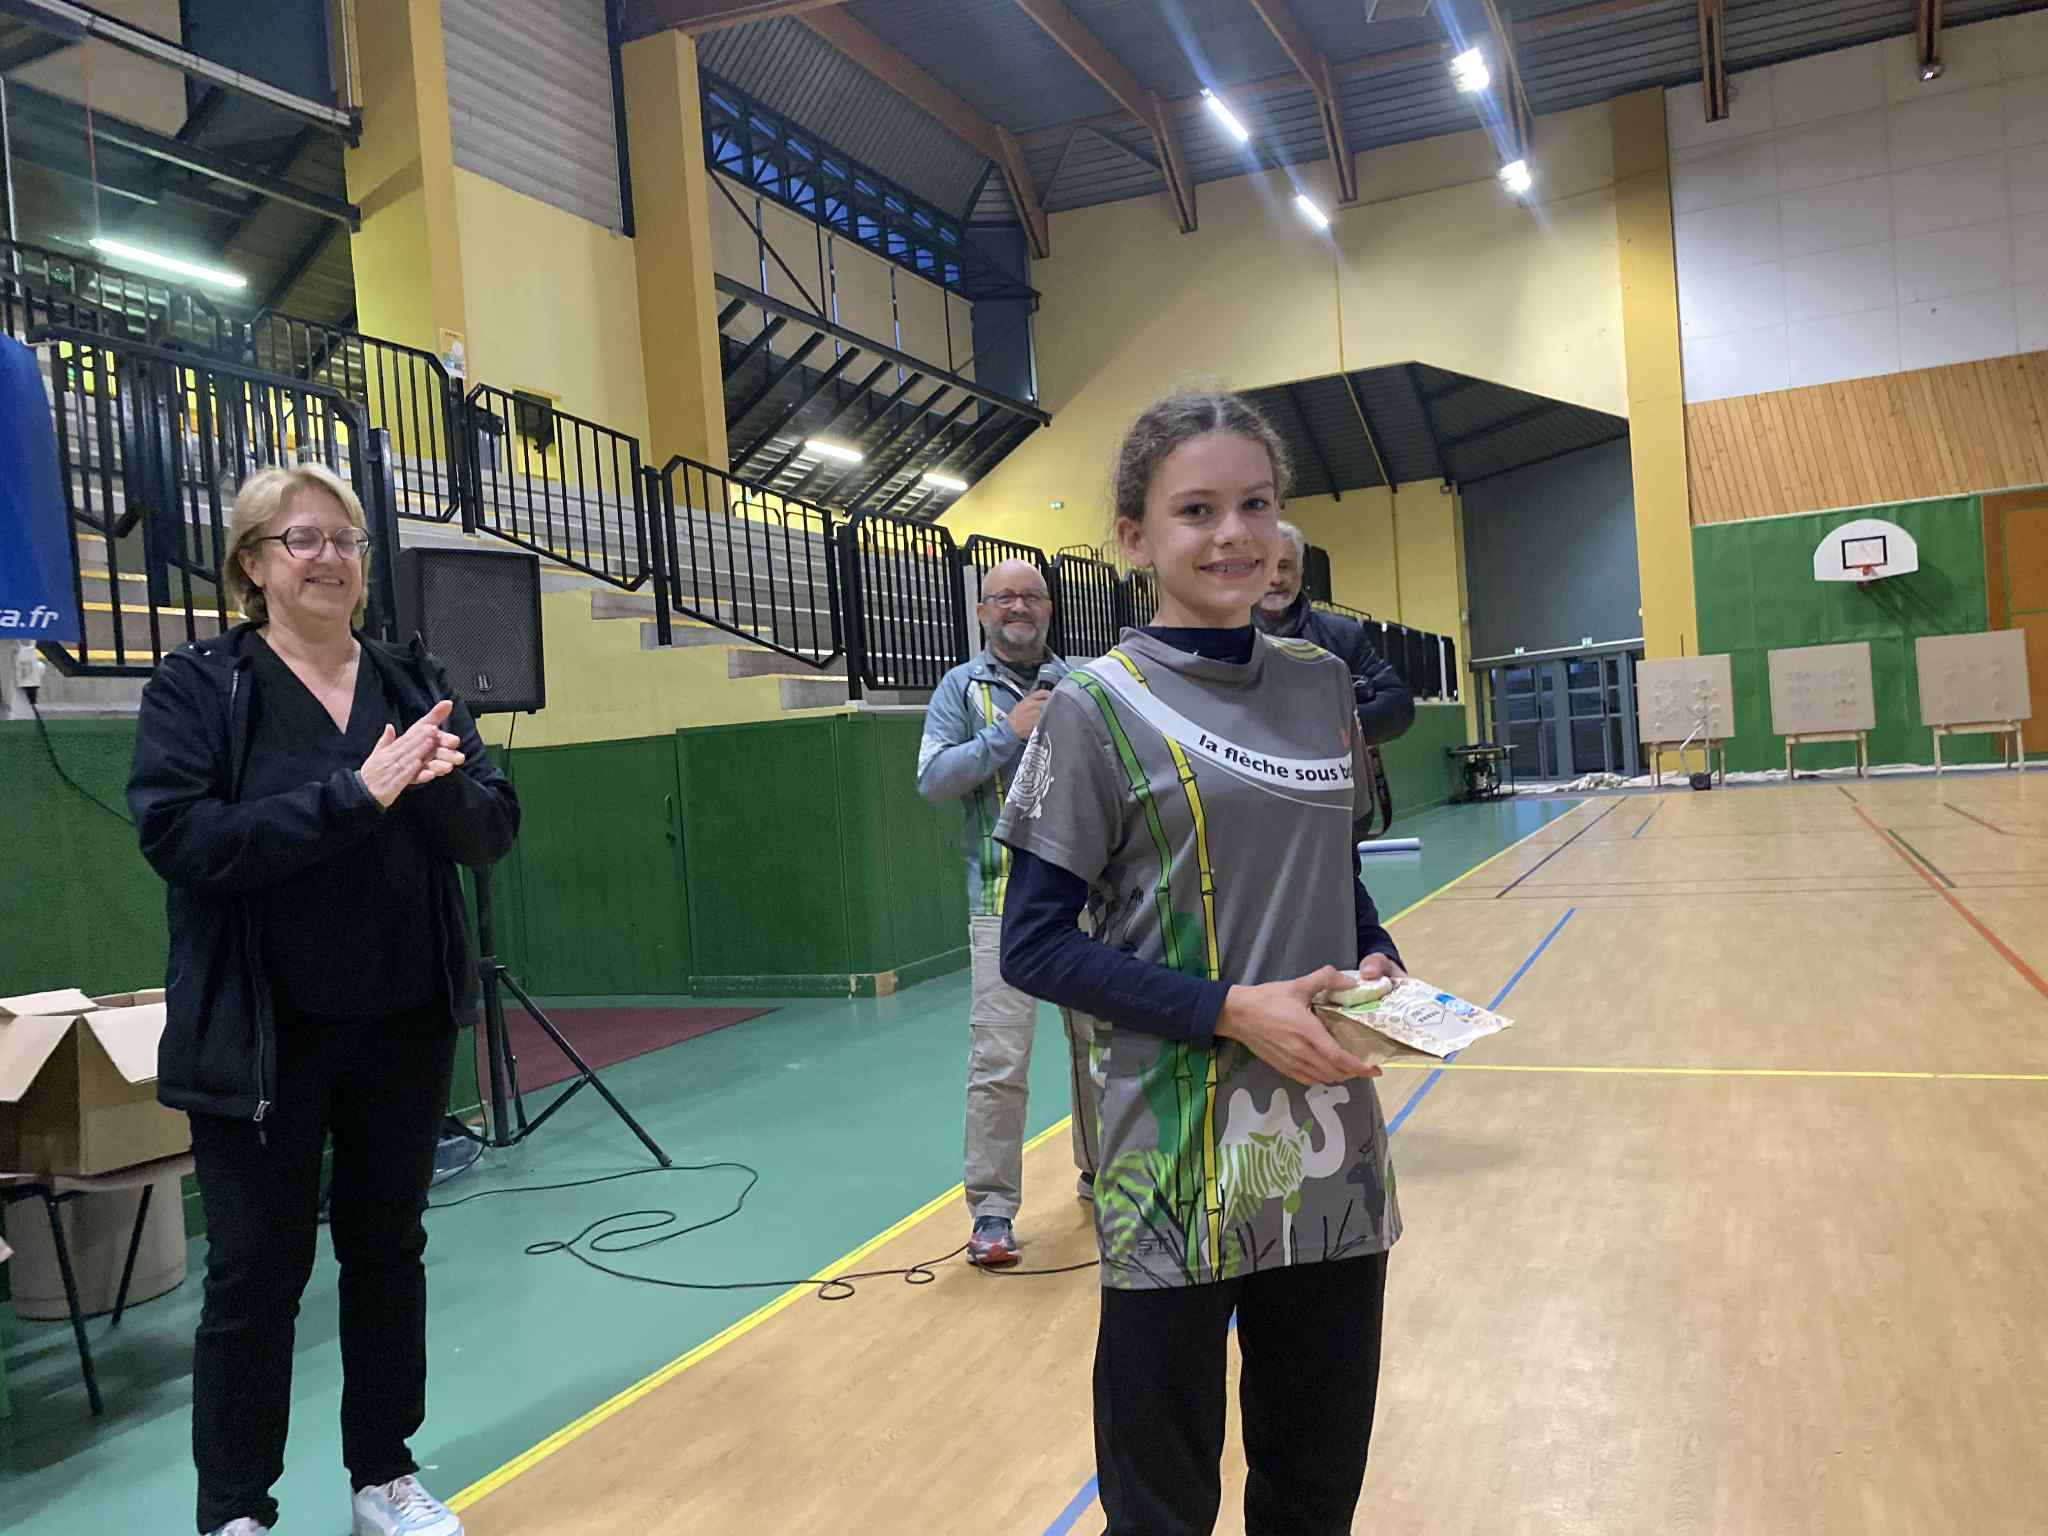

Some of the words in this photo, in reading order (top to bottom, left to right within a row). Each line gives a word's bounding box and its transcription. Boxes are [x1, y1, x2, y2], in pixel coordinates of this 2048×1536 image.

[0, 604, 59, 628] a.fr
[1198, 734, 1218, 753] la
[1224, 746, 1289, 778] flèche
[1295, 768, 1338, 781] sous
